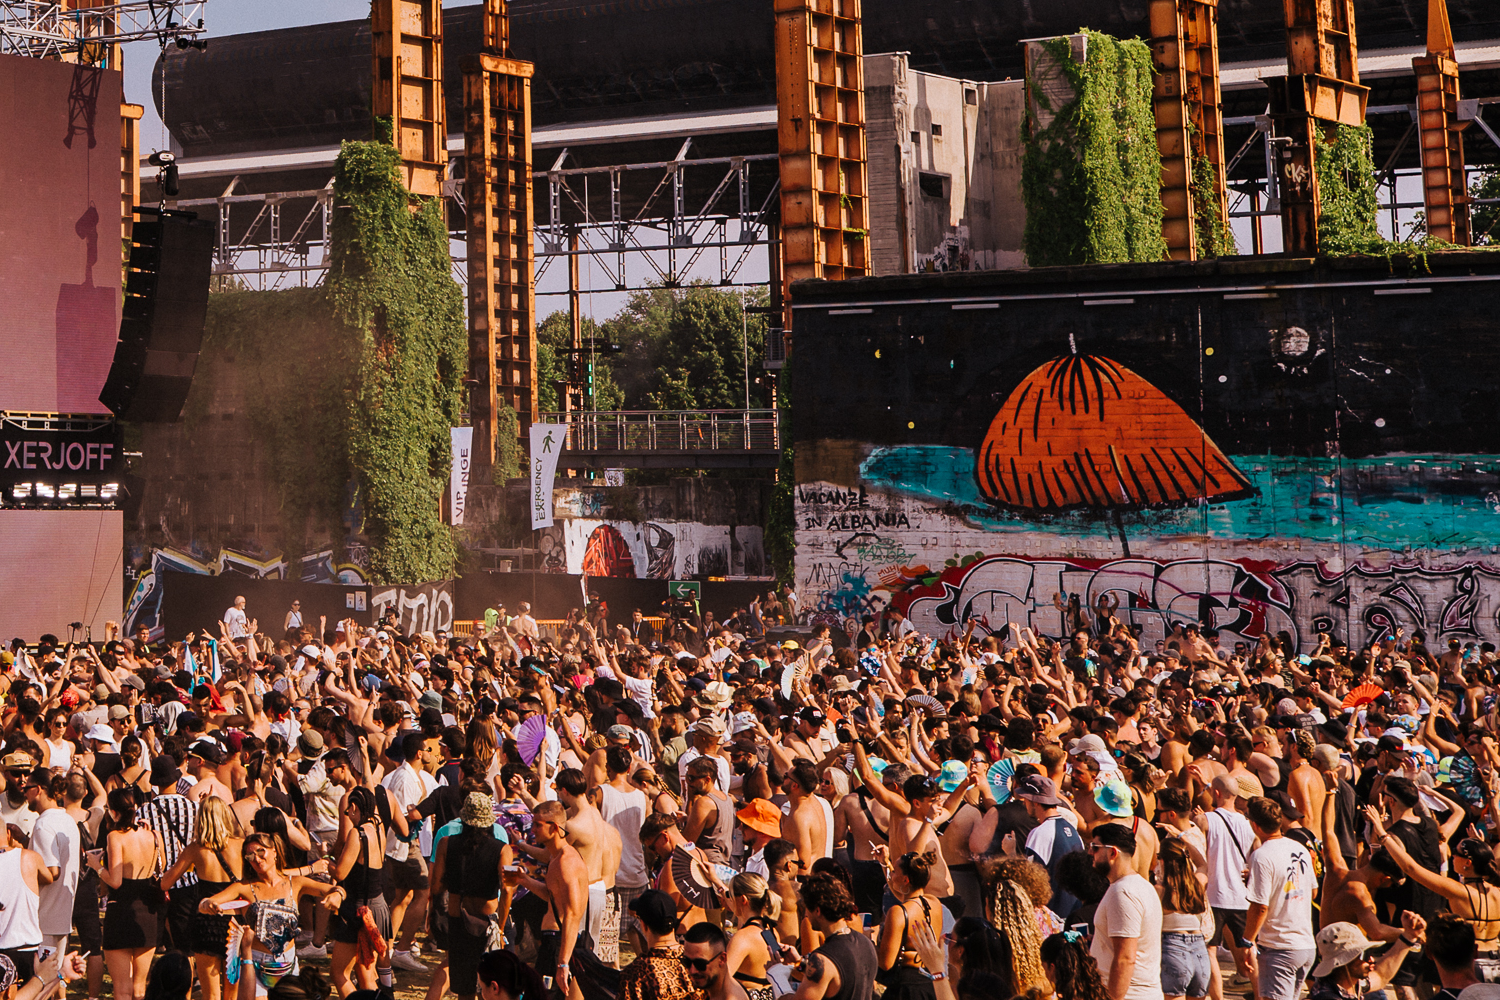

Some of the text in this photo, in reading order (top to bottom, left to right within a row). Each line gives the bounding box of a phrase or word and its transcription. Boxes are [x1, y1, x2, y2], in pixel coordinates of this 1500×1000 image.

[3, 440, 114, 471] XERJOFF
[455, 491, 464, 518] VIP
[805, 516, 822, 529] IN
